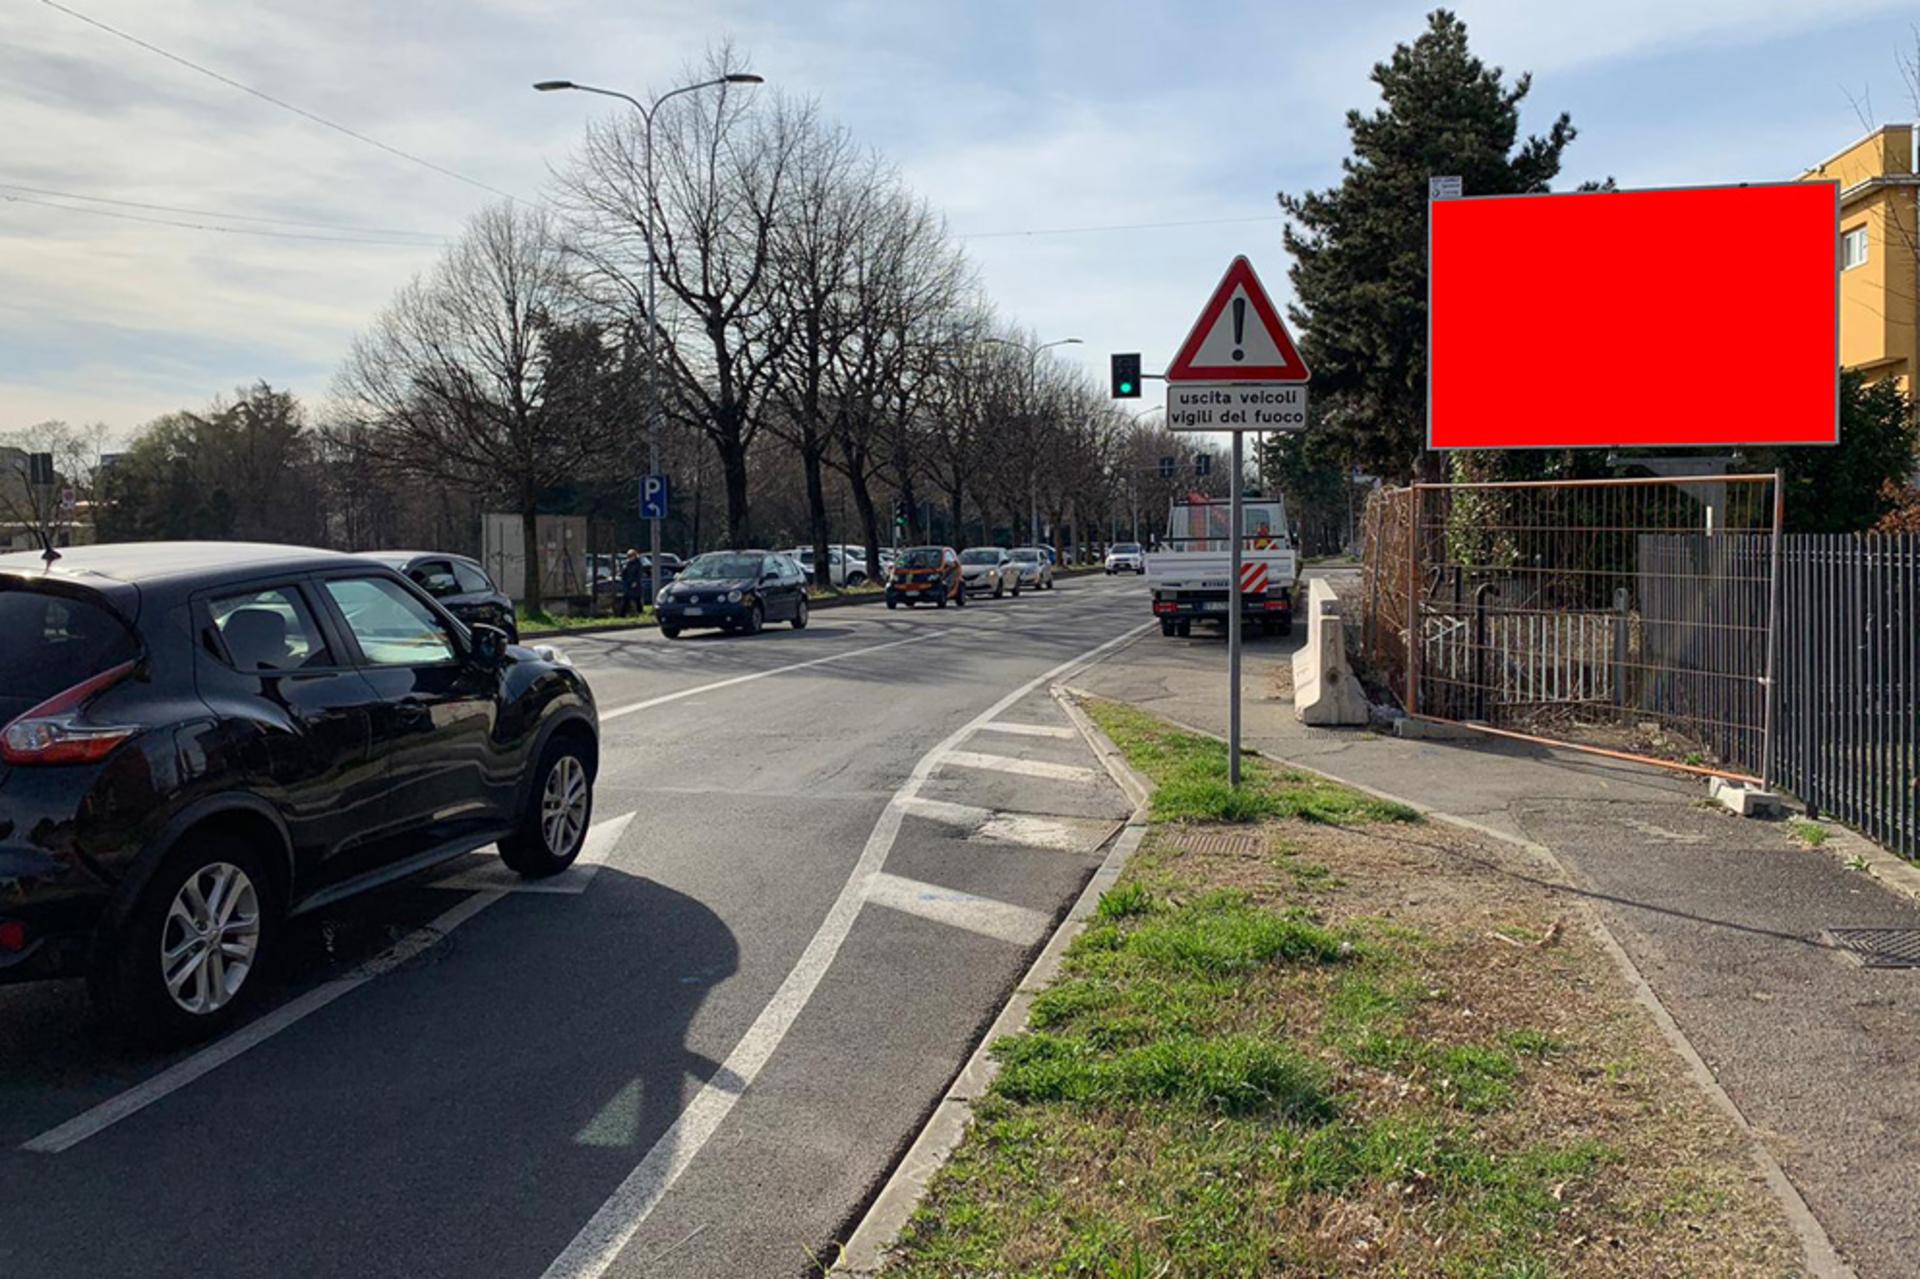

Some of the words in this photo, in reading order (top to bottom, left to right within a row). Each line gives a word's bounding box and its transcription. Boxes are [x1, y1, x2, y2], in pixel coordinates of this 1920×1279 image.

[1180, 390, 1232, 404] uscita
[1240, 390, 1296, 404] veicoli
[1171, 410, 1212, 426] vigili
[1219, 410, 1246, 423] del
[1254, 410, 1304, 423] fuoco
[645, 478, 661, 501] P
